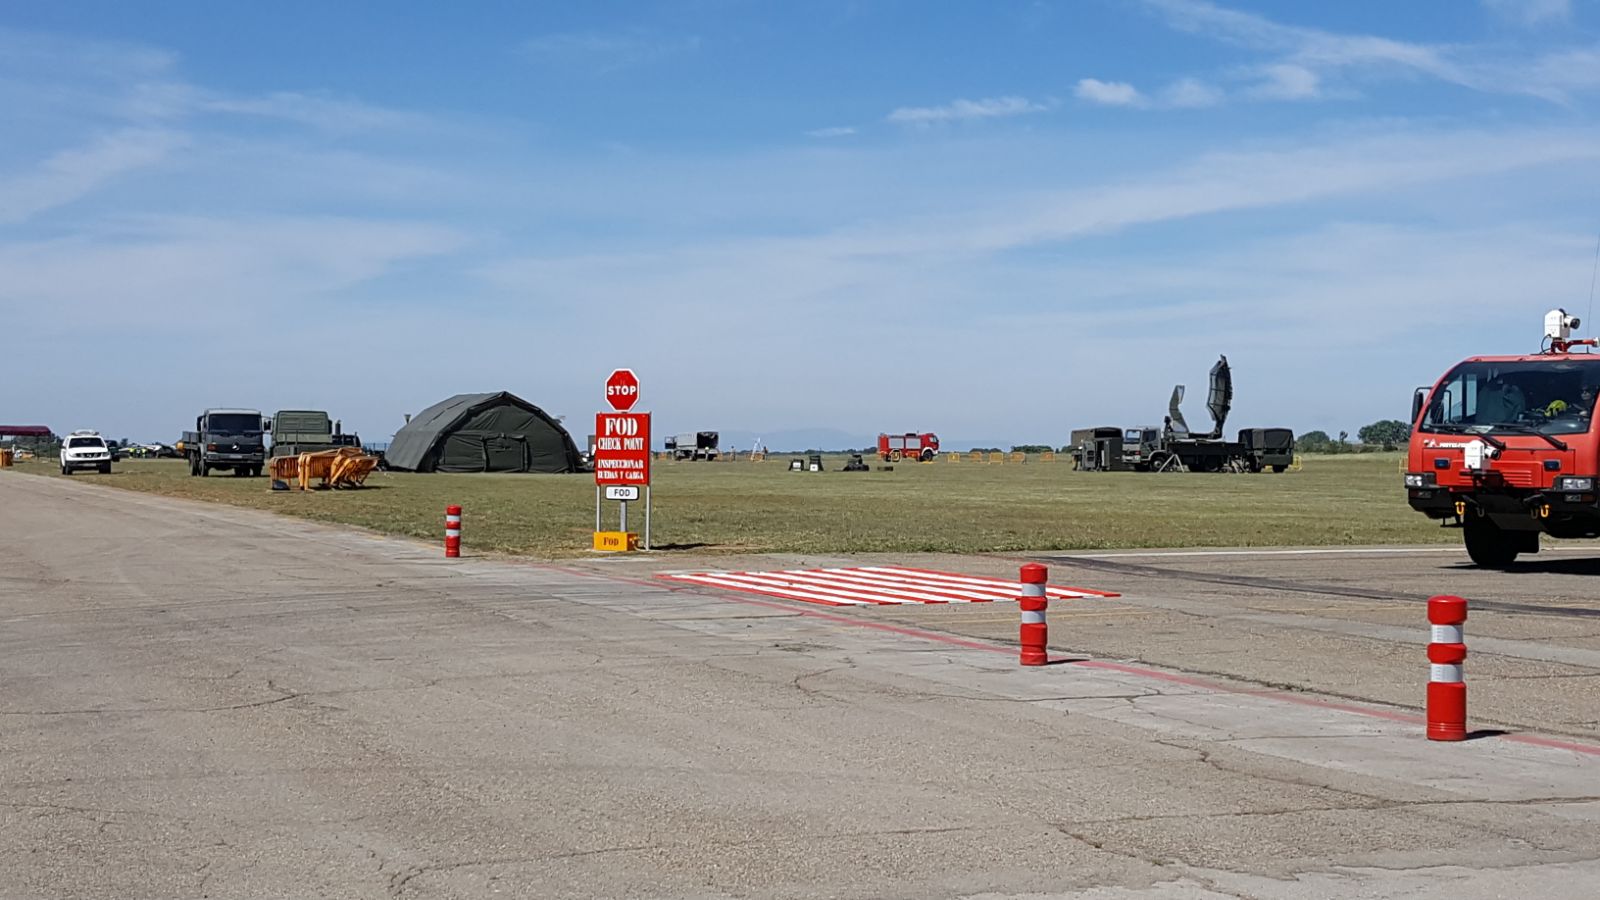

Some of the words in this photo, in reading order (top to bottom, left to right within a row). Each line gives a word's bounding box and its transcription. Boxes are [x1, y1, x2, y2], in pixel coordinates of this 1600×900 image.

[608, 385, 637, 396] STOP
[605, 417, 638, 436] FOD
[598, 437, 621, 450] CHECK
[623, 437, 644, 450] POINT
[614, 488, 631, 497] FOD
